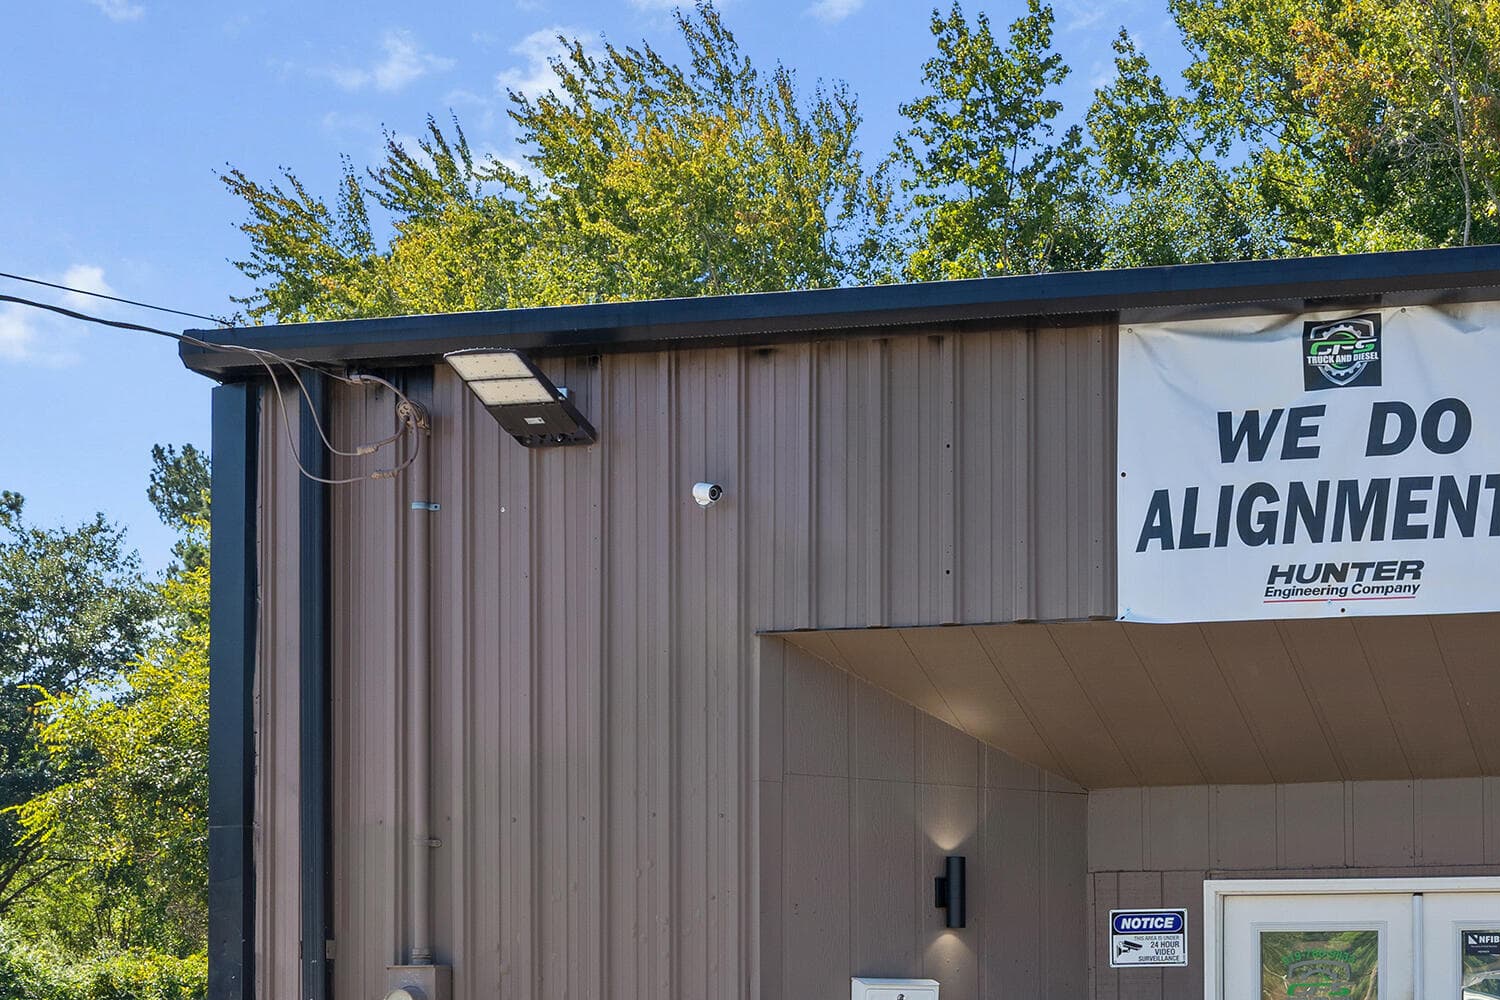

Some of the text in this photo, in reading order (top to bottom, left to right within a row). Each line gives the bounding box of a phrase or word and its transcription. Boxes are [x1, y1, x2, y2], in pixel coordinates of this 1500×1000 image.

[1307, 352, 1379, 365] TRUCK AND DIESEL
[1216, 398, 1473, 464] WE DO
[1267, 560, 1425, 585] HUNTER
[1264, 583, 1421, 600] Engineering Company
[1120, 916, 1175, 930] NOTICE
[1478, 935, 1500, 944] NFIB
[1154, 948, 1176, 956] VIDEO
